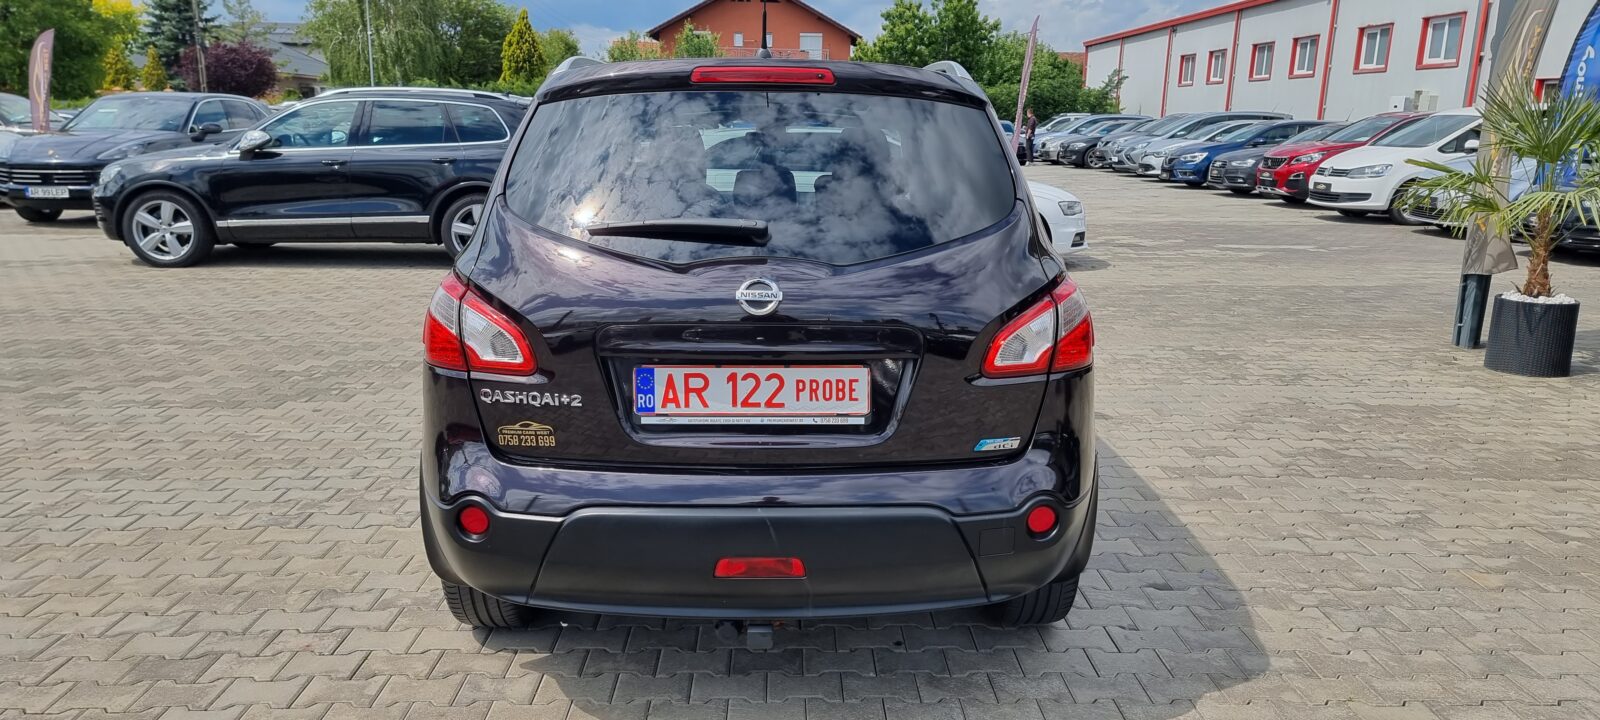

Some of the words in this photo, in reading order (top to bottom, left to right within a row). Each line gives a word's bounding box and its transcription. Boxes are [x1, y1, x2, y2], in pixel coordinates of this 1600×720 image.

[740, 291, 778, 299] NISSAN
[660, 372, 710, 409] AR
[726, 371, 786, 409] 122
[795, 378, 860, 402] PROBE
[637, 393, 654, 408] RO
[498, 434, 519, 446] 0758
[520, 435, 536, 446] 233
[538, 435, 556, 447] 699
